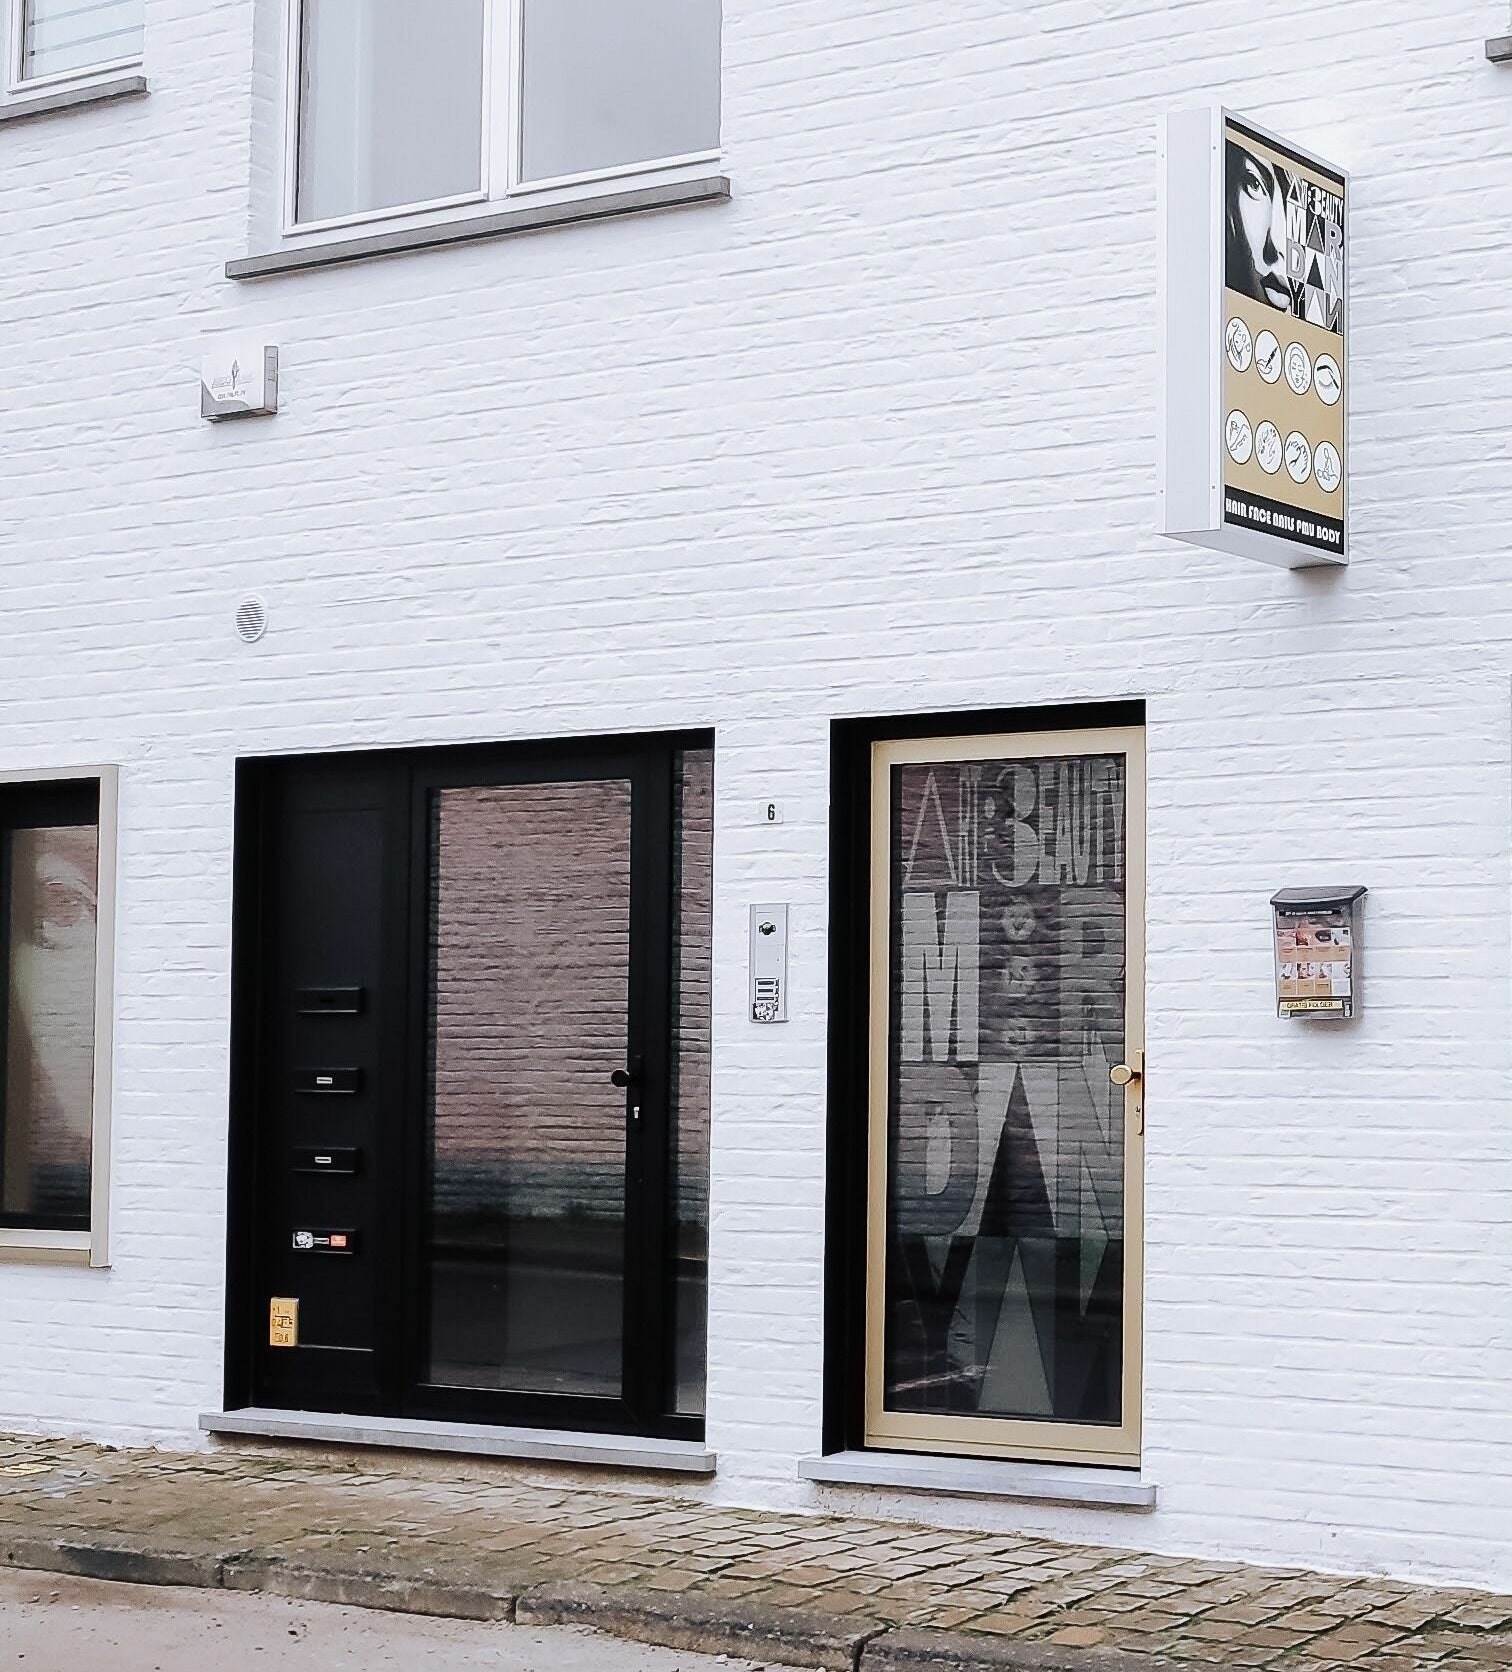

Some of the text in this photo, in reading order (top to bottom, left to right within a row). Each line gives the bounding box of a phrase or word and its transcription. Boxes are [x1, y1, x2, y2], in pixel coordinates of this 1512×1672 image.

[1225, 498, 1341, 544] HAIR FACE NAILS PMU BODY
[767, 803, 775, 820] 6
